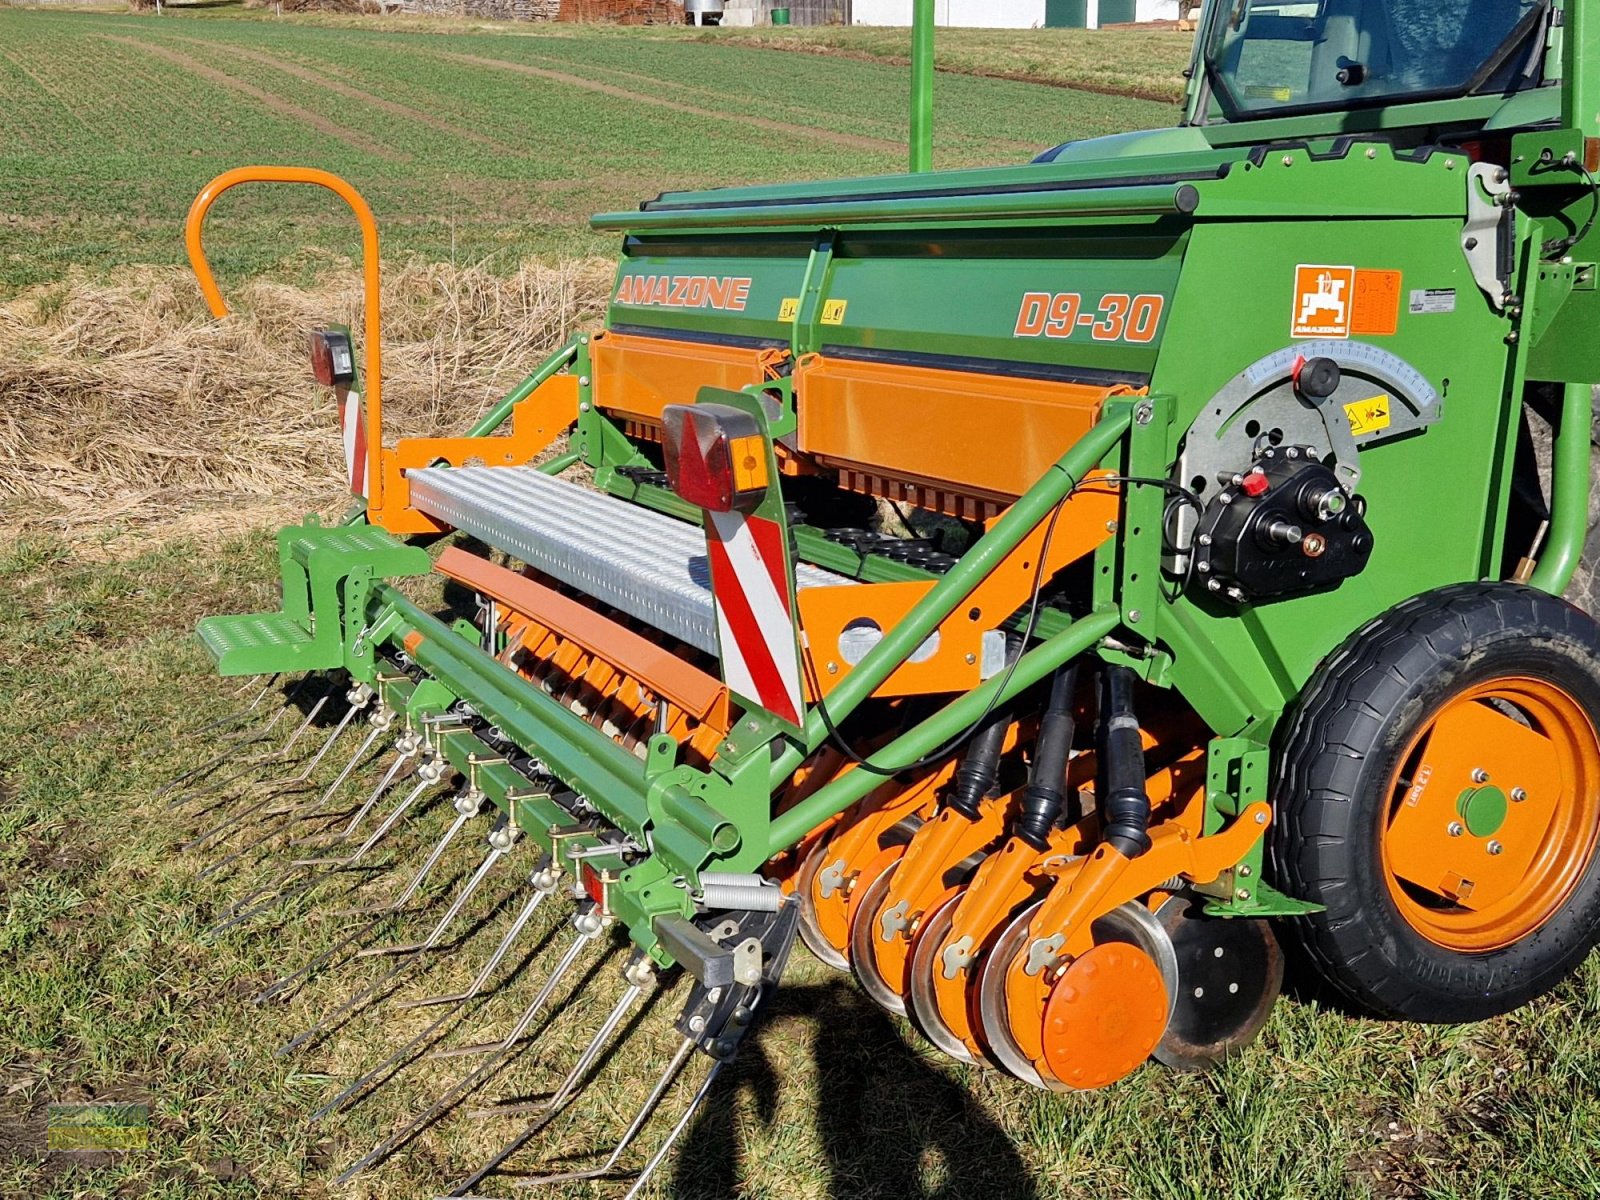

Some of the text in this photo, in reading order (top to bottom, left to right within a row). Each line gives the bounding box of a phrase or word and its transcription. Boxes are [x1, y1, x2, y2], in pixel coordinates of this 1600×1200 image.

[613, 275, 752, 311] AMAZONE
[1013, 292, 1164, 343] D9-30
[1409, 785, 1423, 803] bar
